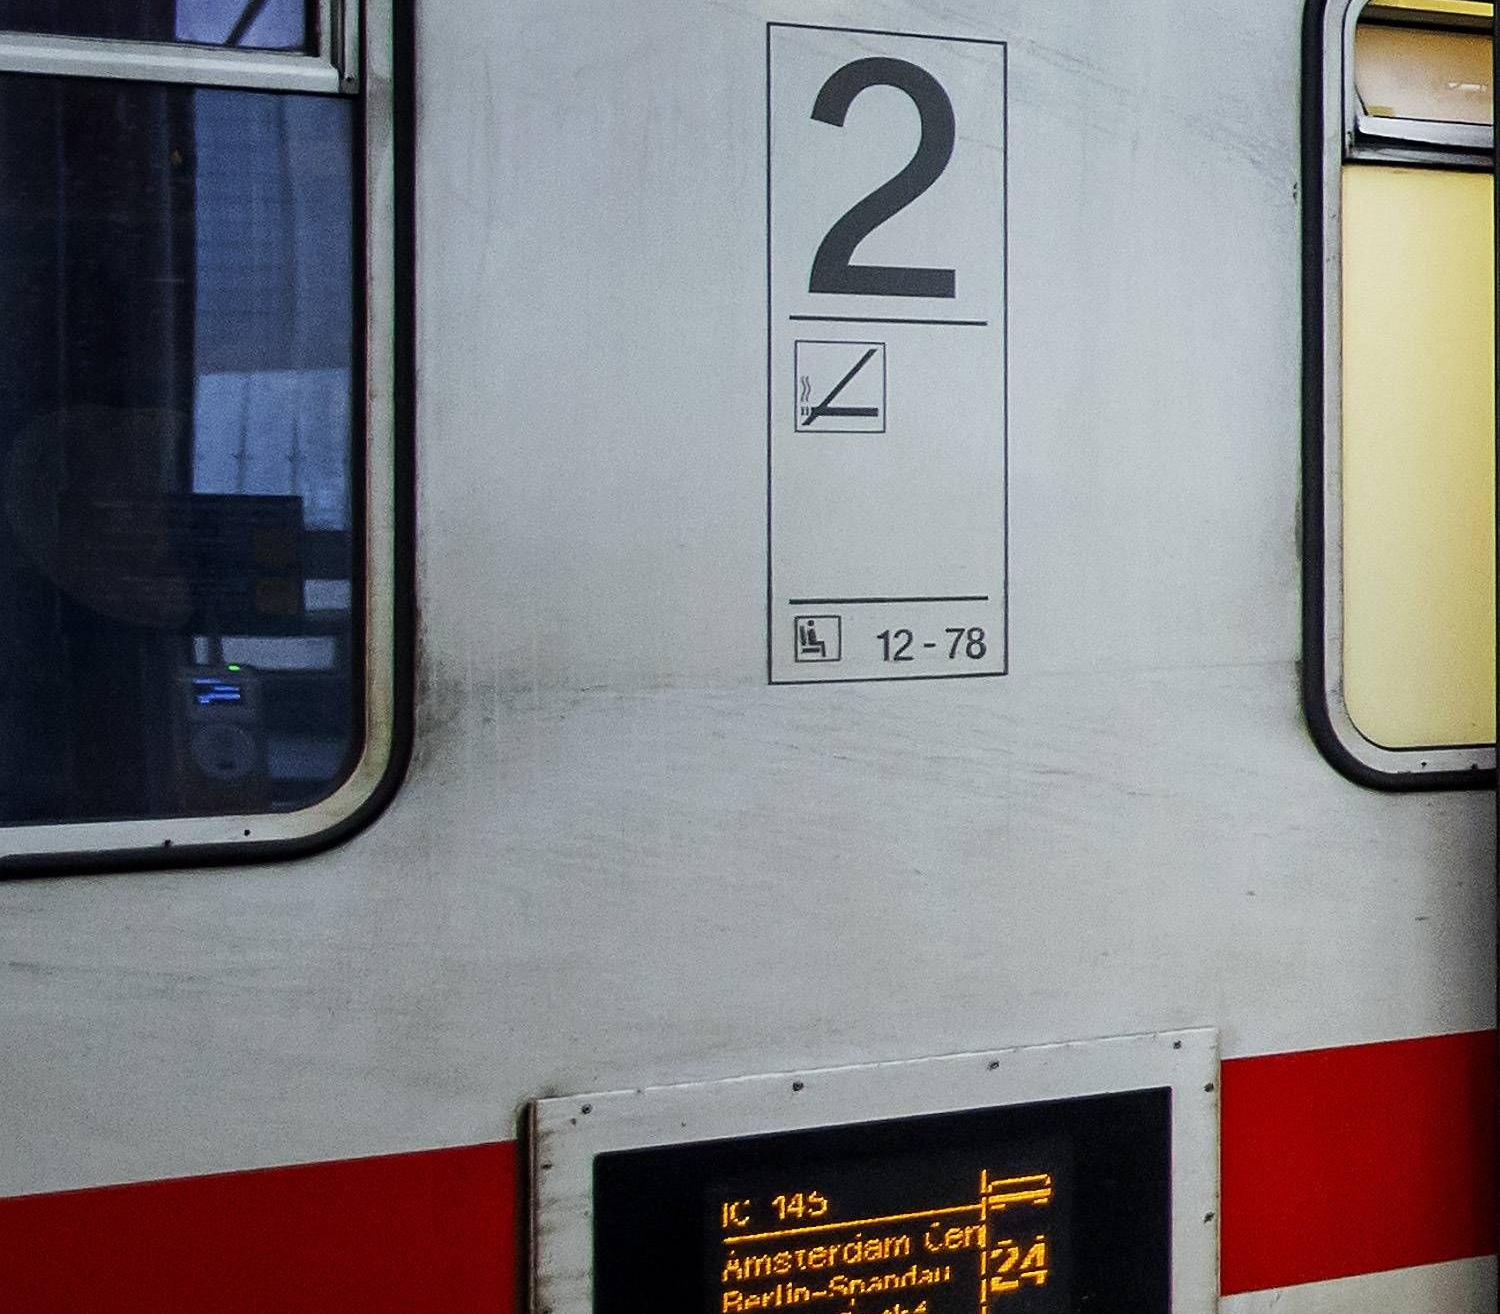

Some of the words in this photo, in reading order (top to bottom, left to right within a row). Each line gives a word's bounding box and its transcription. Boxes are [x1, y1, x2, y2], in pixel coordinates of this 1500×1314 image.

[808, 56, 956, 299] 2
[722, 1199, 750, 1228] IC
[772, 1190, 828, 1221] 145
[721, 1233, 911, 1283] Amsterdam
[990, 1235, 1048, 1292] 24
[721, 1264, 951, 1314] Berlin-Spandau
